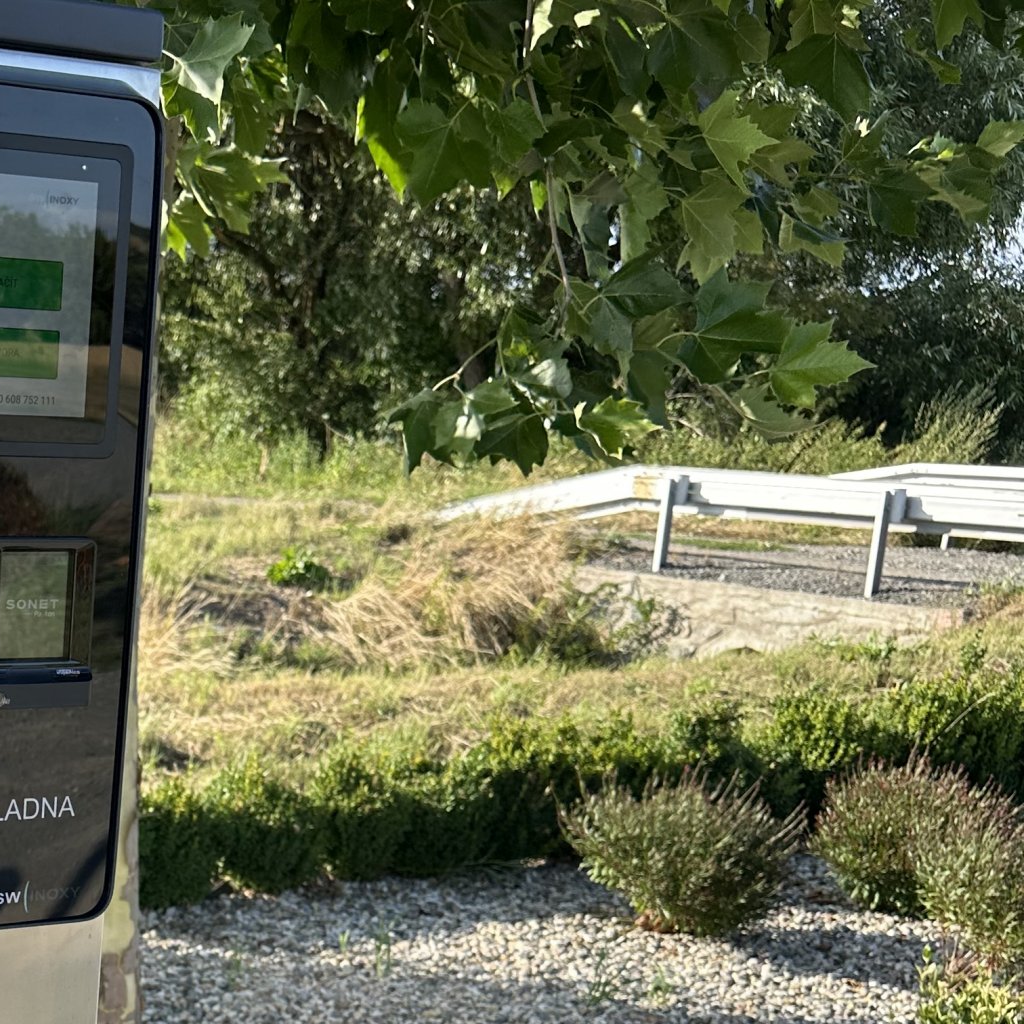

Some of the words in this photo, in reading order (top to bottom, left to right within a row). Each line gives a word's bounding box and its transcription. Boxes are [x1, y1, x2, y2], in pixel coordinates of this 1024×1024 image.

[5, 394, 22, 405] 608
[23, 395, 39, 405] 752
[41, 396, 56, 406] 111
[5, 599, 60, 610] SONET
